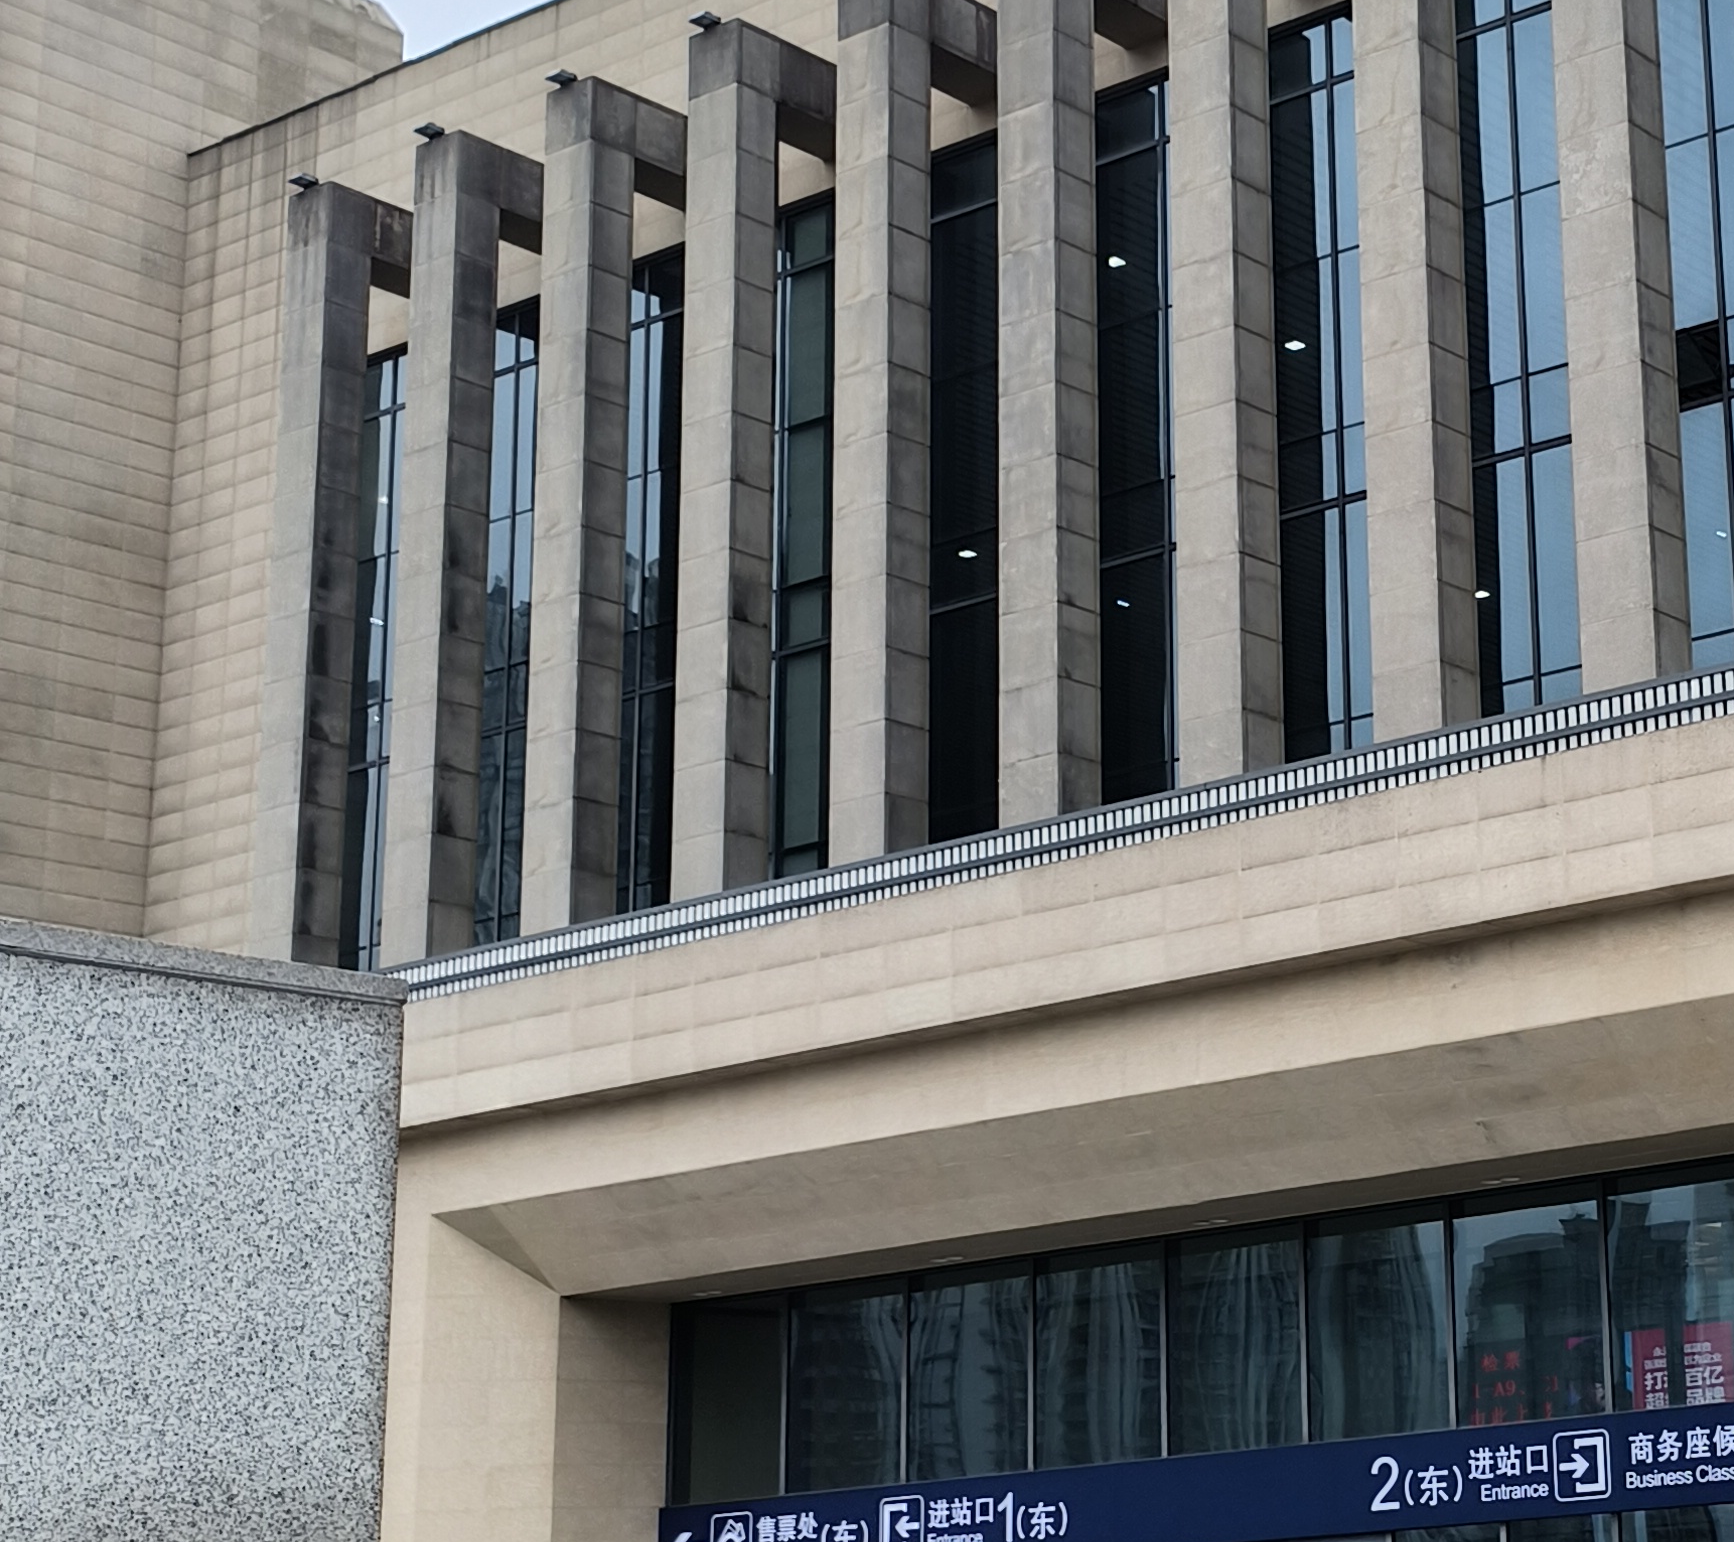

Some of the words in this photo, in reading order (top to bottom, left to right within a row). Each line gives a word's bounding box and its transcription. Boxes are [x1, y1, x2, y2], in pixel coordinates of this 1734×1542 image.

[1644, 1365, 1725, 1391] 打百亿
[1626, 1470, 1694, 1489] Business
[1480, 1483, 1550, 1502] Entrance
